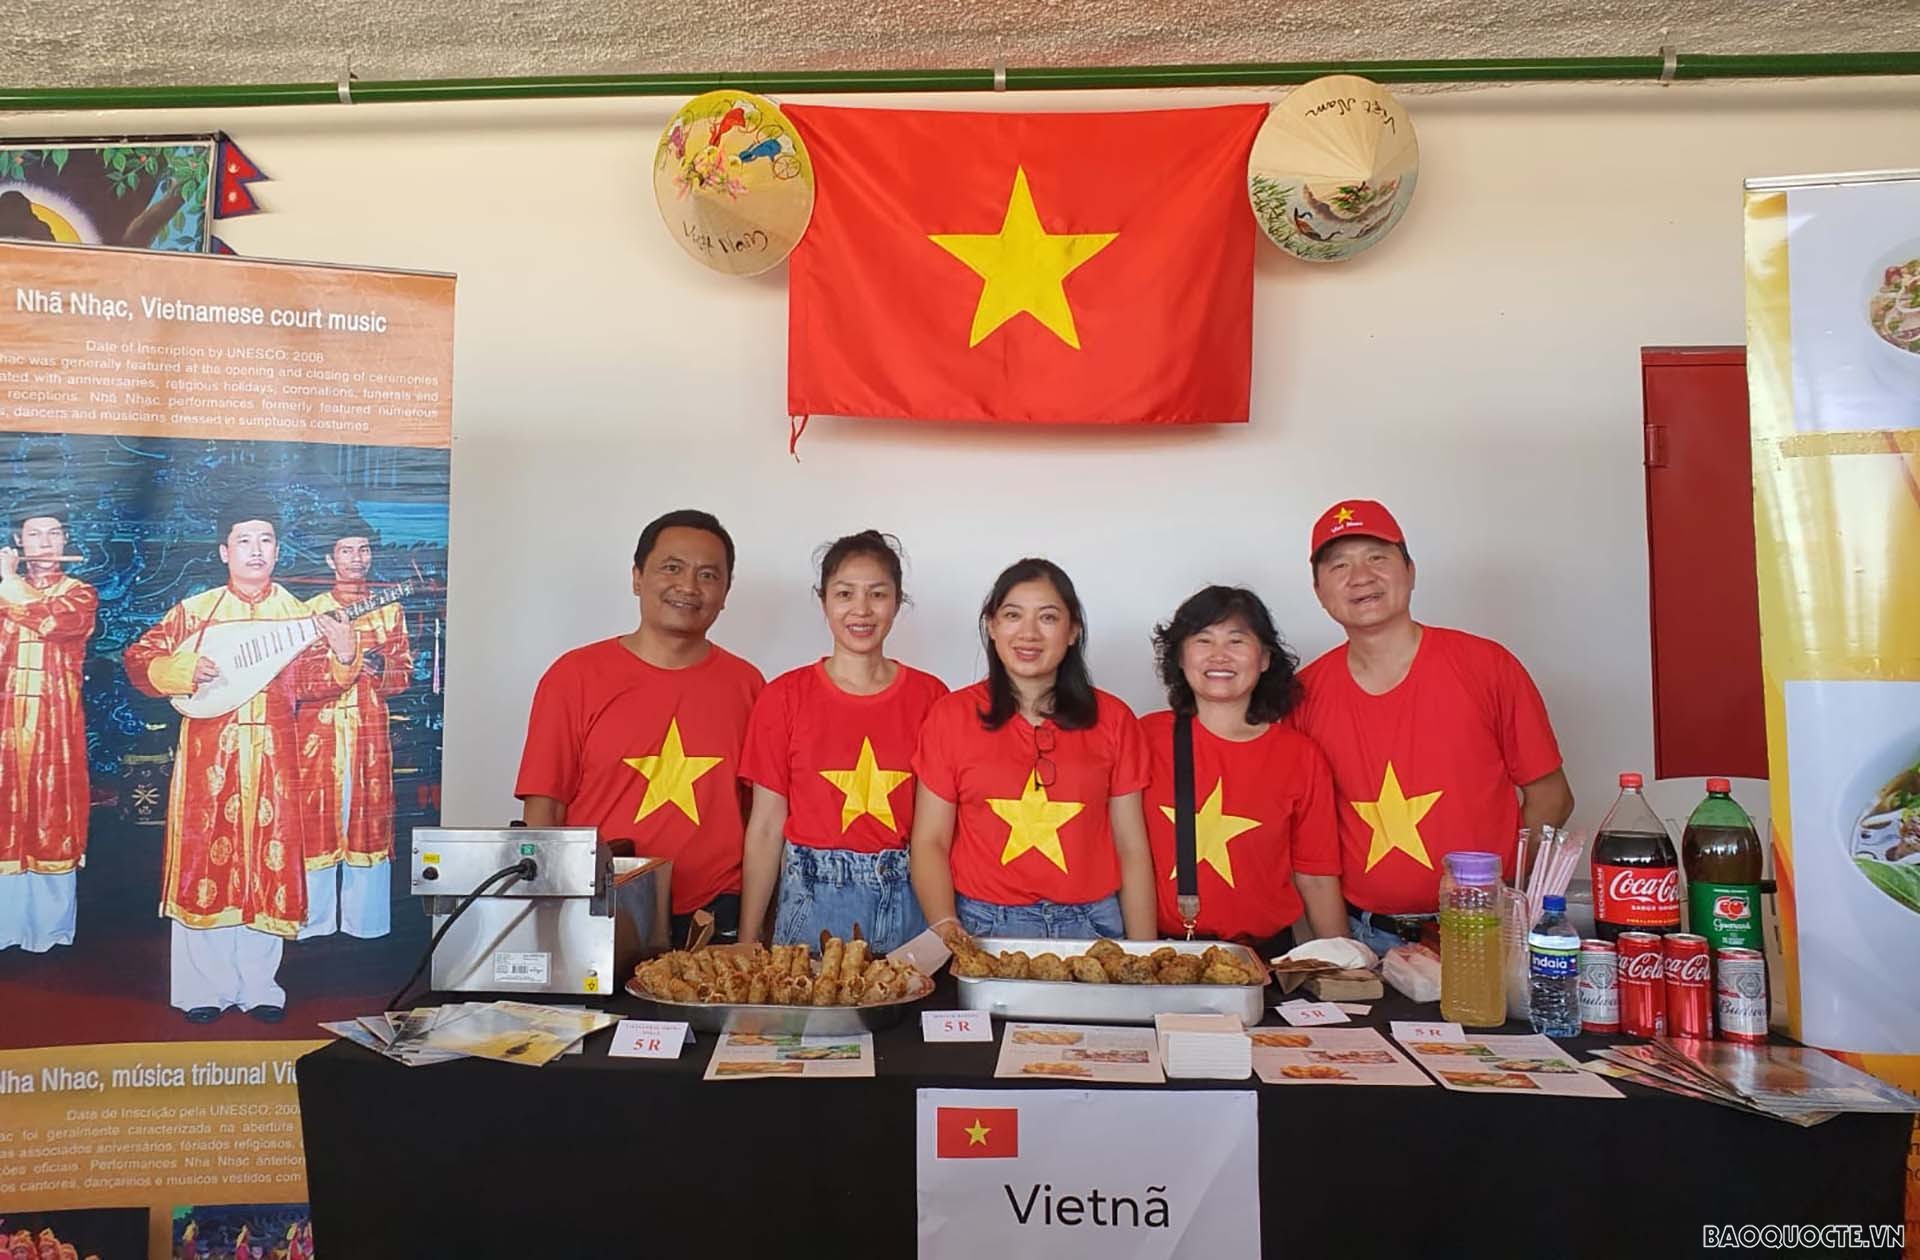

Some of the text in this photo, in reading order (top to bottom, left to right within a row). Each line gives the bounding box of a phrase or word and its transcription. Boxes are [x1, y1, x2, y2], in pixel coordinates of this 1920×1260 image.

[16, 287, 388, 333] Nhã Nhạc, Vietnamese court music
[121, 341, 137, 354] of
[137, 342, 205, 358] Inscription
[208, 346, 223, 360] by
[60, 357, 121, 372] generally
[125, 360, 181, 374] featured
[185, 363, 199, 374] at
[201, 362, 222, 375] the
[225, 365, 275, 380] opening
[278, 367, 303, 379] and
[305, 367, 351, 384] closing
[352, 371, 367, 383] of
[33, 373, 62, 385] with
[166, 379, 219, 394] religious
[13, 405, 69, 418] dancers
[71, 409, 97, 420] and
[100, 411, 166, 423] musicians
[171, 414, 222, 425] dressed
[224, 415, 236, 425] in
[239, 417, 308, 429] sumptuous
[168, 396, 256, 409] performances
[262, 399, 313, 414] formerly
[320, 401, 371, 415] featured
[378, 405, 439, 418] numerous
[944, 1019, 972, 1032] 5 R
[633, 1038, 662, 1052] 5 R
[41, 1065, 105, 1093] Nhac,
[111, 1062, 185, 1088] música
[191, 1061, 267, 1086] tribunal
[1004, 1183, 1170, 1228] Vietnã
